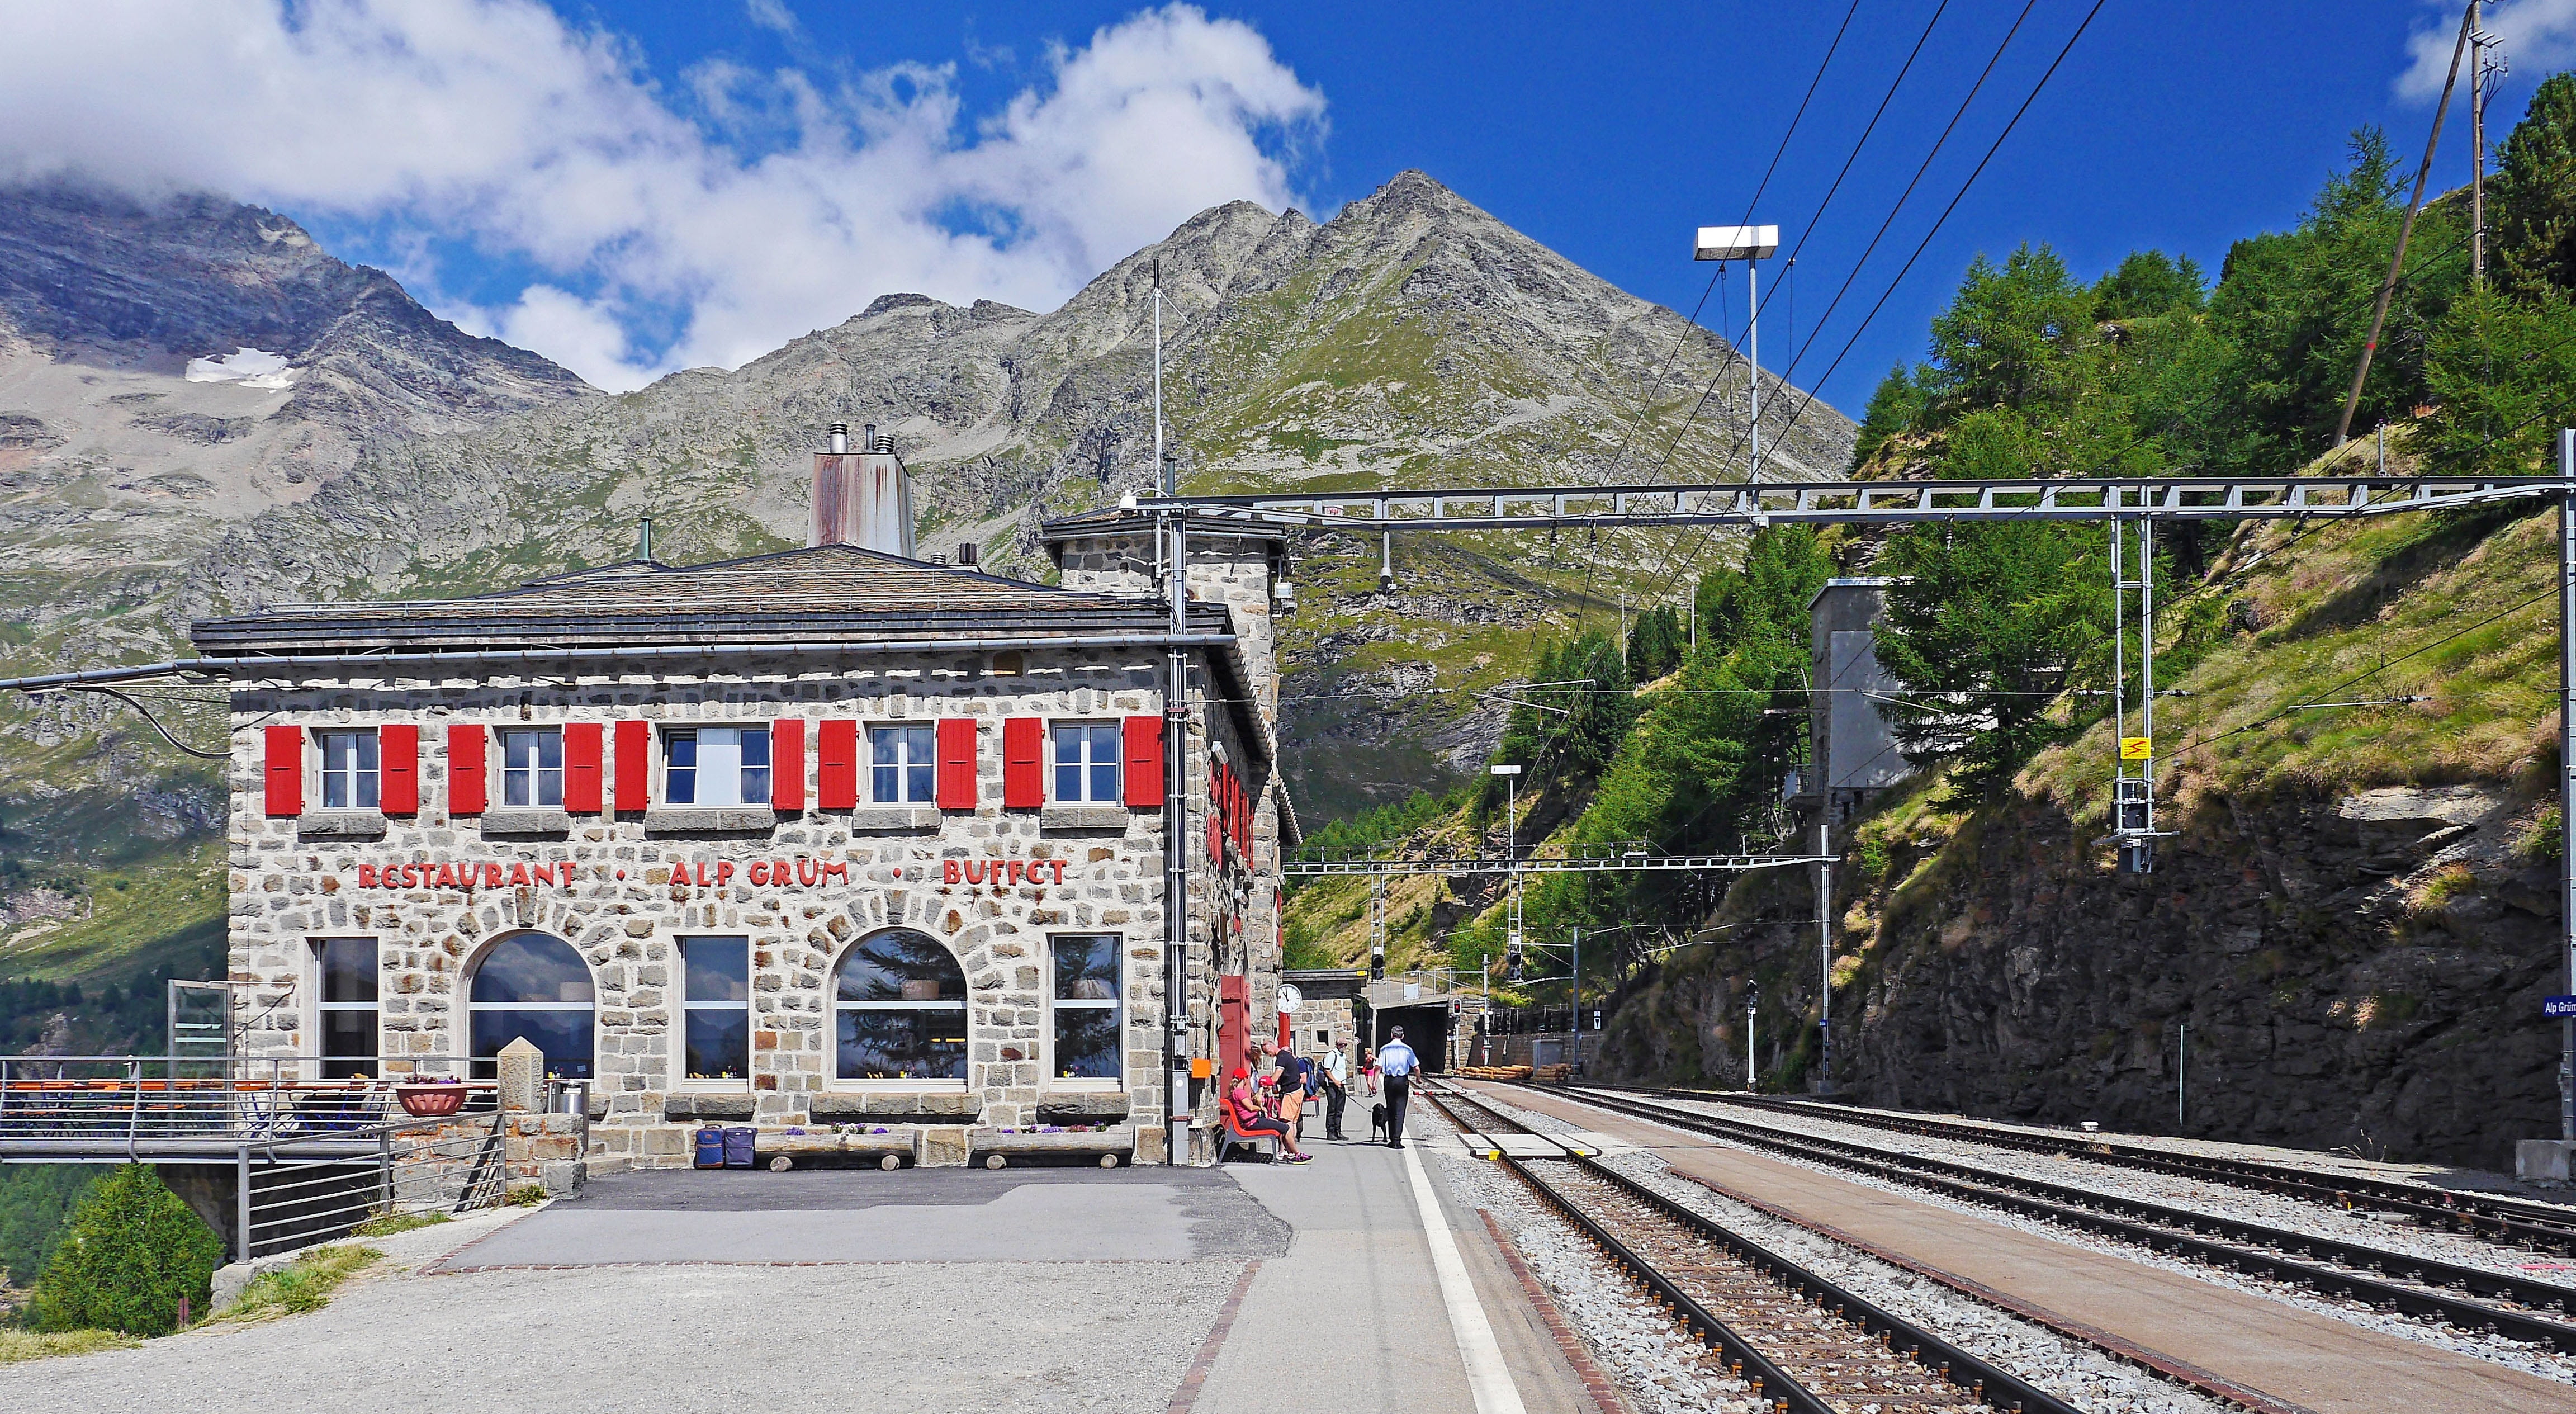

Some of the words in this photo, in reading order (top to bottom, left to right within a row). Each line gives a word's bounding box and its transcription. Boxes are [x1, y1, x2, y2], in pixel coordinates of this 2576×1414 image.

[358, 862, 576, 890] RESTAURANT
[669, 861, 734, 887] ALP
[750, 859, 849, 887] GRÜM
[944, 859, 1067, 886] BUFFET
[2545, 1002, 2556, 1014] Alp
